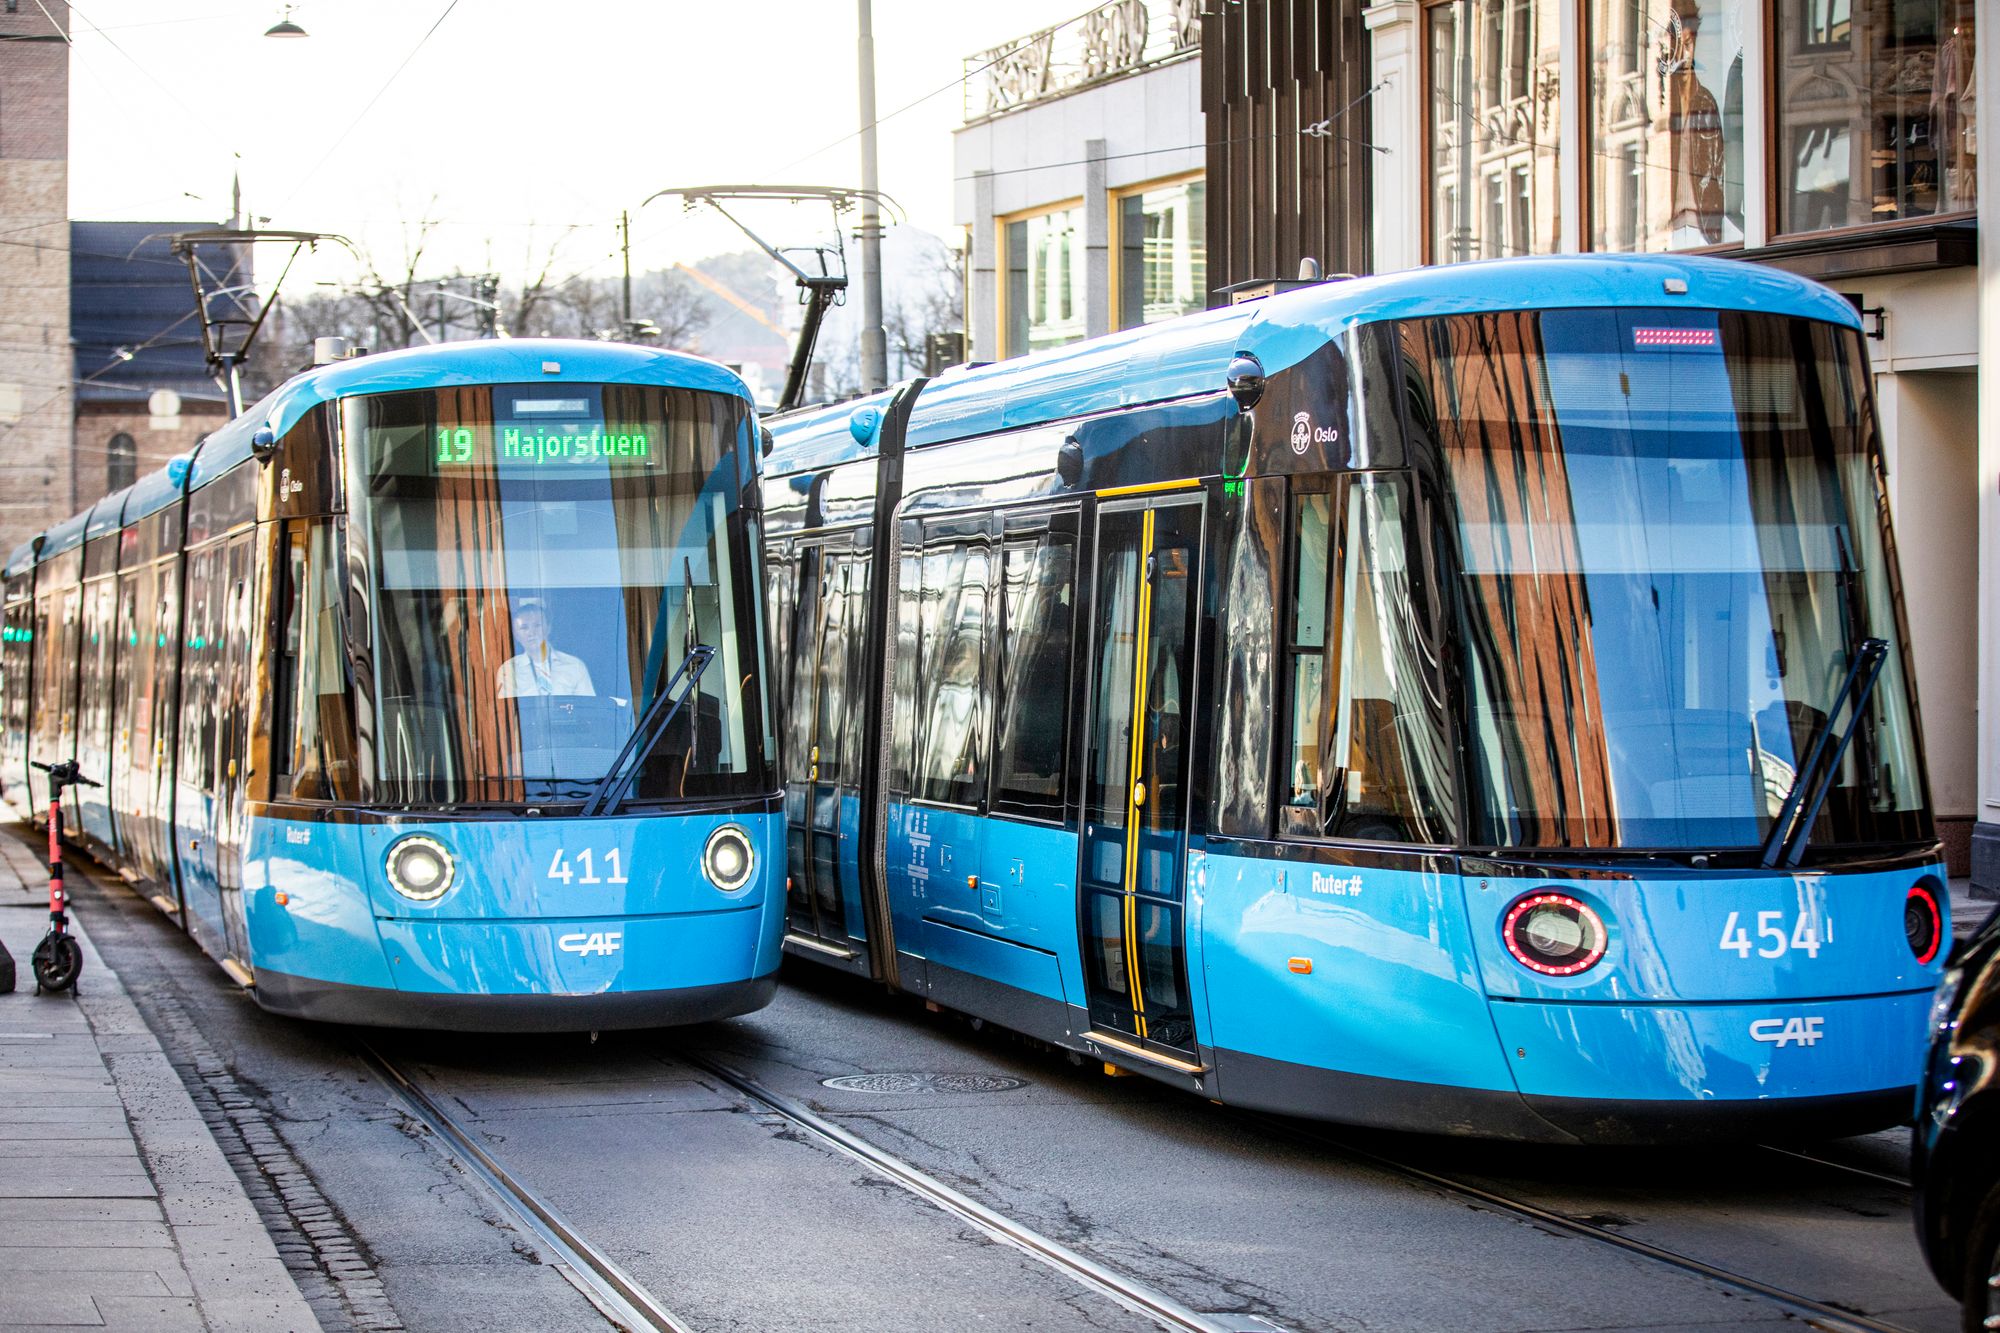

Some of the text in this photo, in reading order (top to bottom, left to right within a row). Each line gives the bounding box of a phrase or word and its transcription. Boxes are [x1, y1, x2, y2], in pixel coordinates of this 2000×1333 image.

[437, 428, 647, 464] 19 Majorstuen
[1314, 427, 1338, 443] Oslo
[547, 847, 628, 885] 411
[1312, 871, 1363, 897] Ruter#
[558, 932, 622, 957] CAF
[1719, 911, 1821, 959] 454
[1749, 1016, 1825, 1048] CAF
